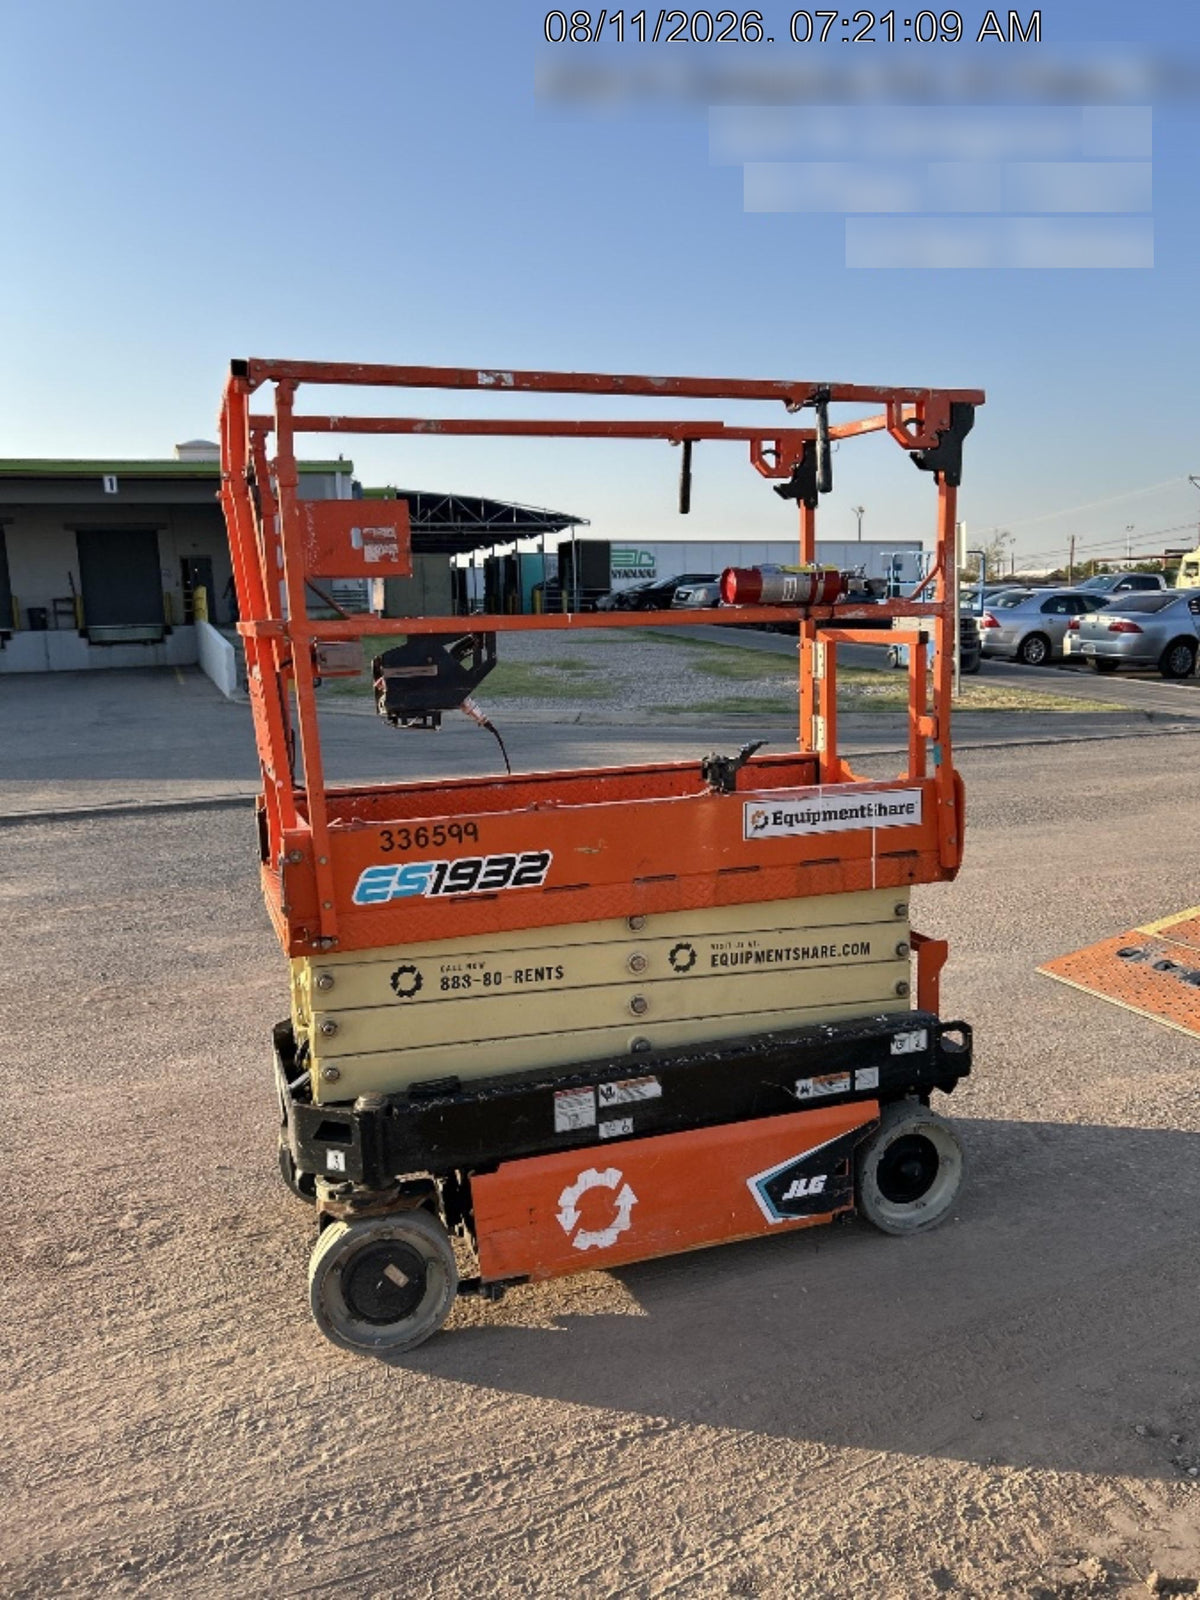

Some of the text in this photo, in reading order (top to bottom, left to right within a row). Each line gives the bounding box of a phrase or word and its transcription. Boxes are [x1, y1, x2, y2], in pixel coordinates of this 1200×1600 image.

[379, 822, 479, 851] 336599
[353, 850, 552, 904] ES1932
[710, 942, 871, 968] EQUIPMENTSHARE.COM
[440, 964, 463, 973] CALL
[440, 965, 564, 991] 888-80-RENTS
[782, 1174, 828, 1201] JLG
